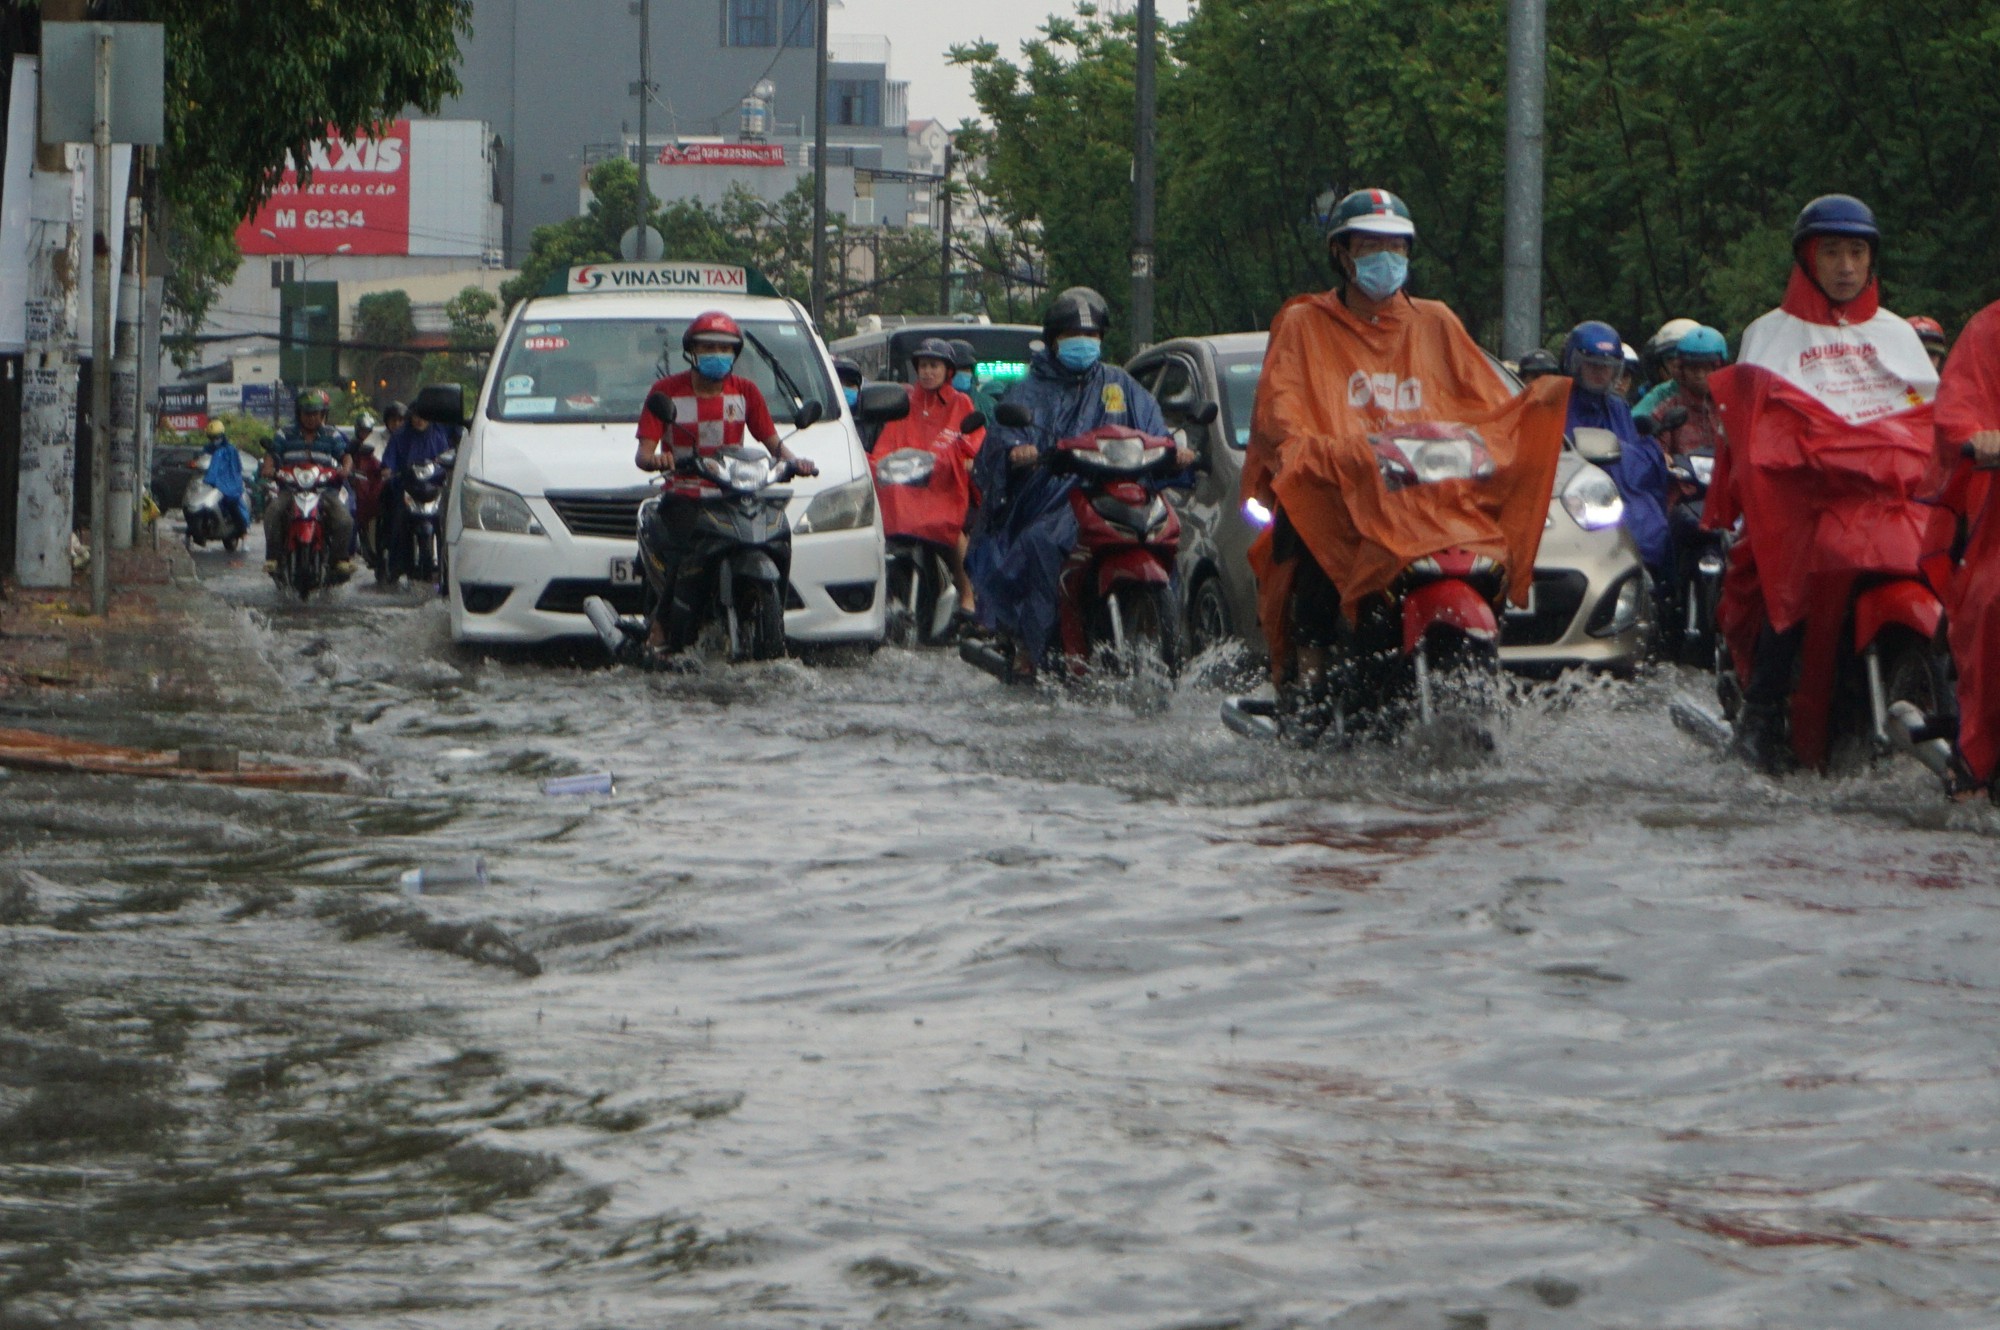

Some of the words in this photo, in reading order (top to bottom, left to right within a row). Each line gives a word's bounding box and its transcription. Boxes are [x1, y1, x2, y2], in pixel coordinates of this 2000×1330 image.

[329, 183, 361, 195] CAO
[275, 209, 296, 228] M
[304, 209, 365, 228] 6234
[611, 269, 700, 286] VINASUN
[703, 269, 744, 286] TAXI
